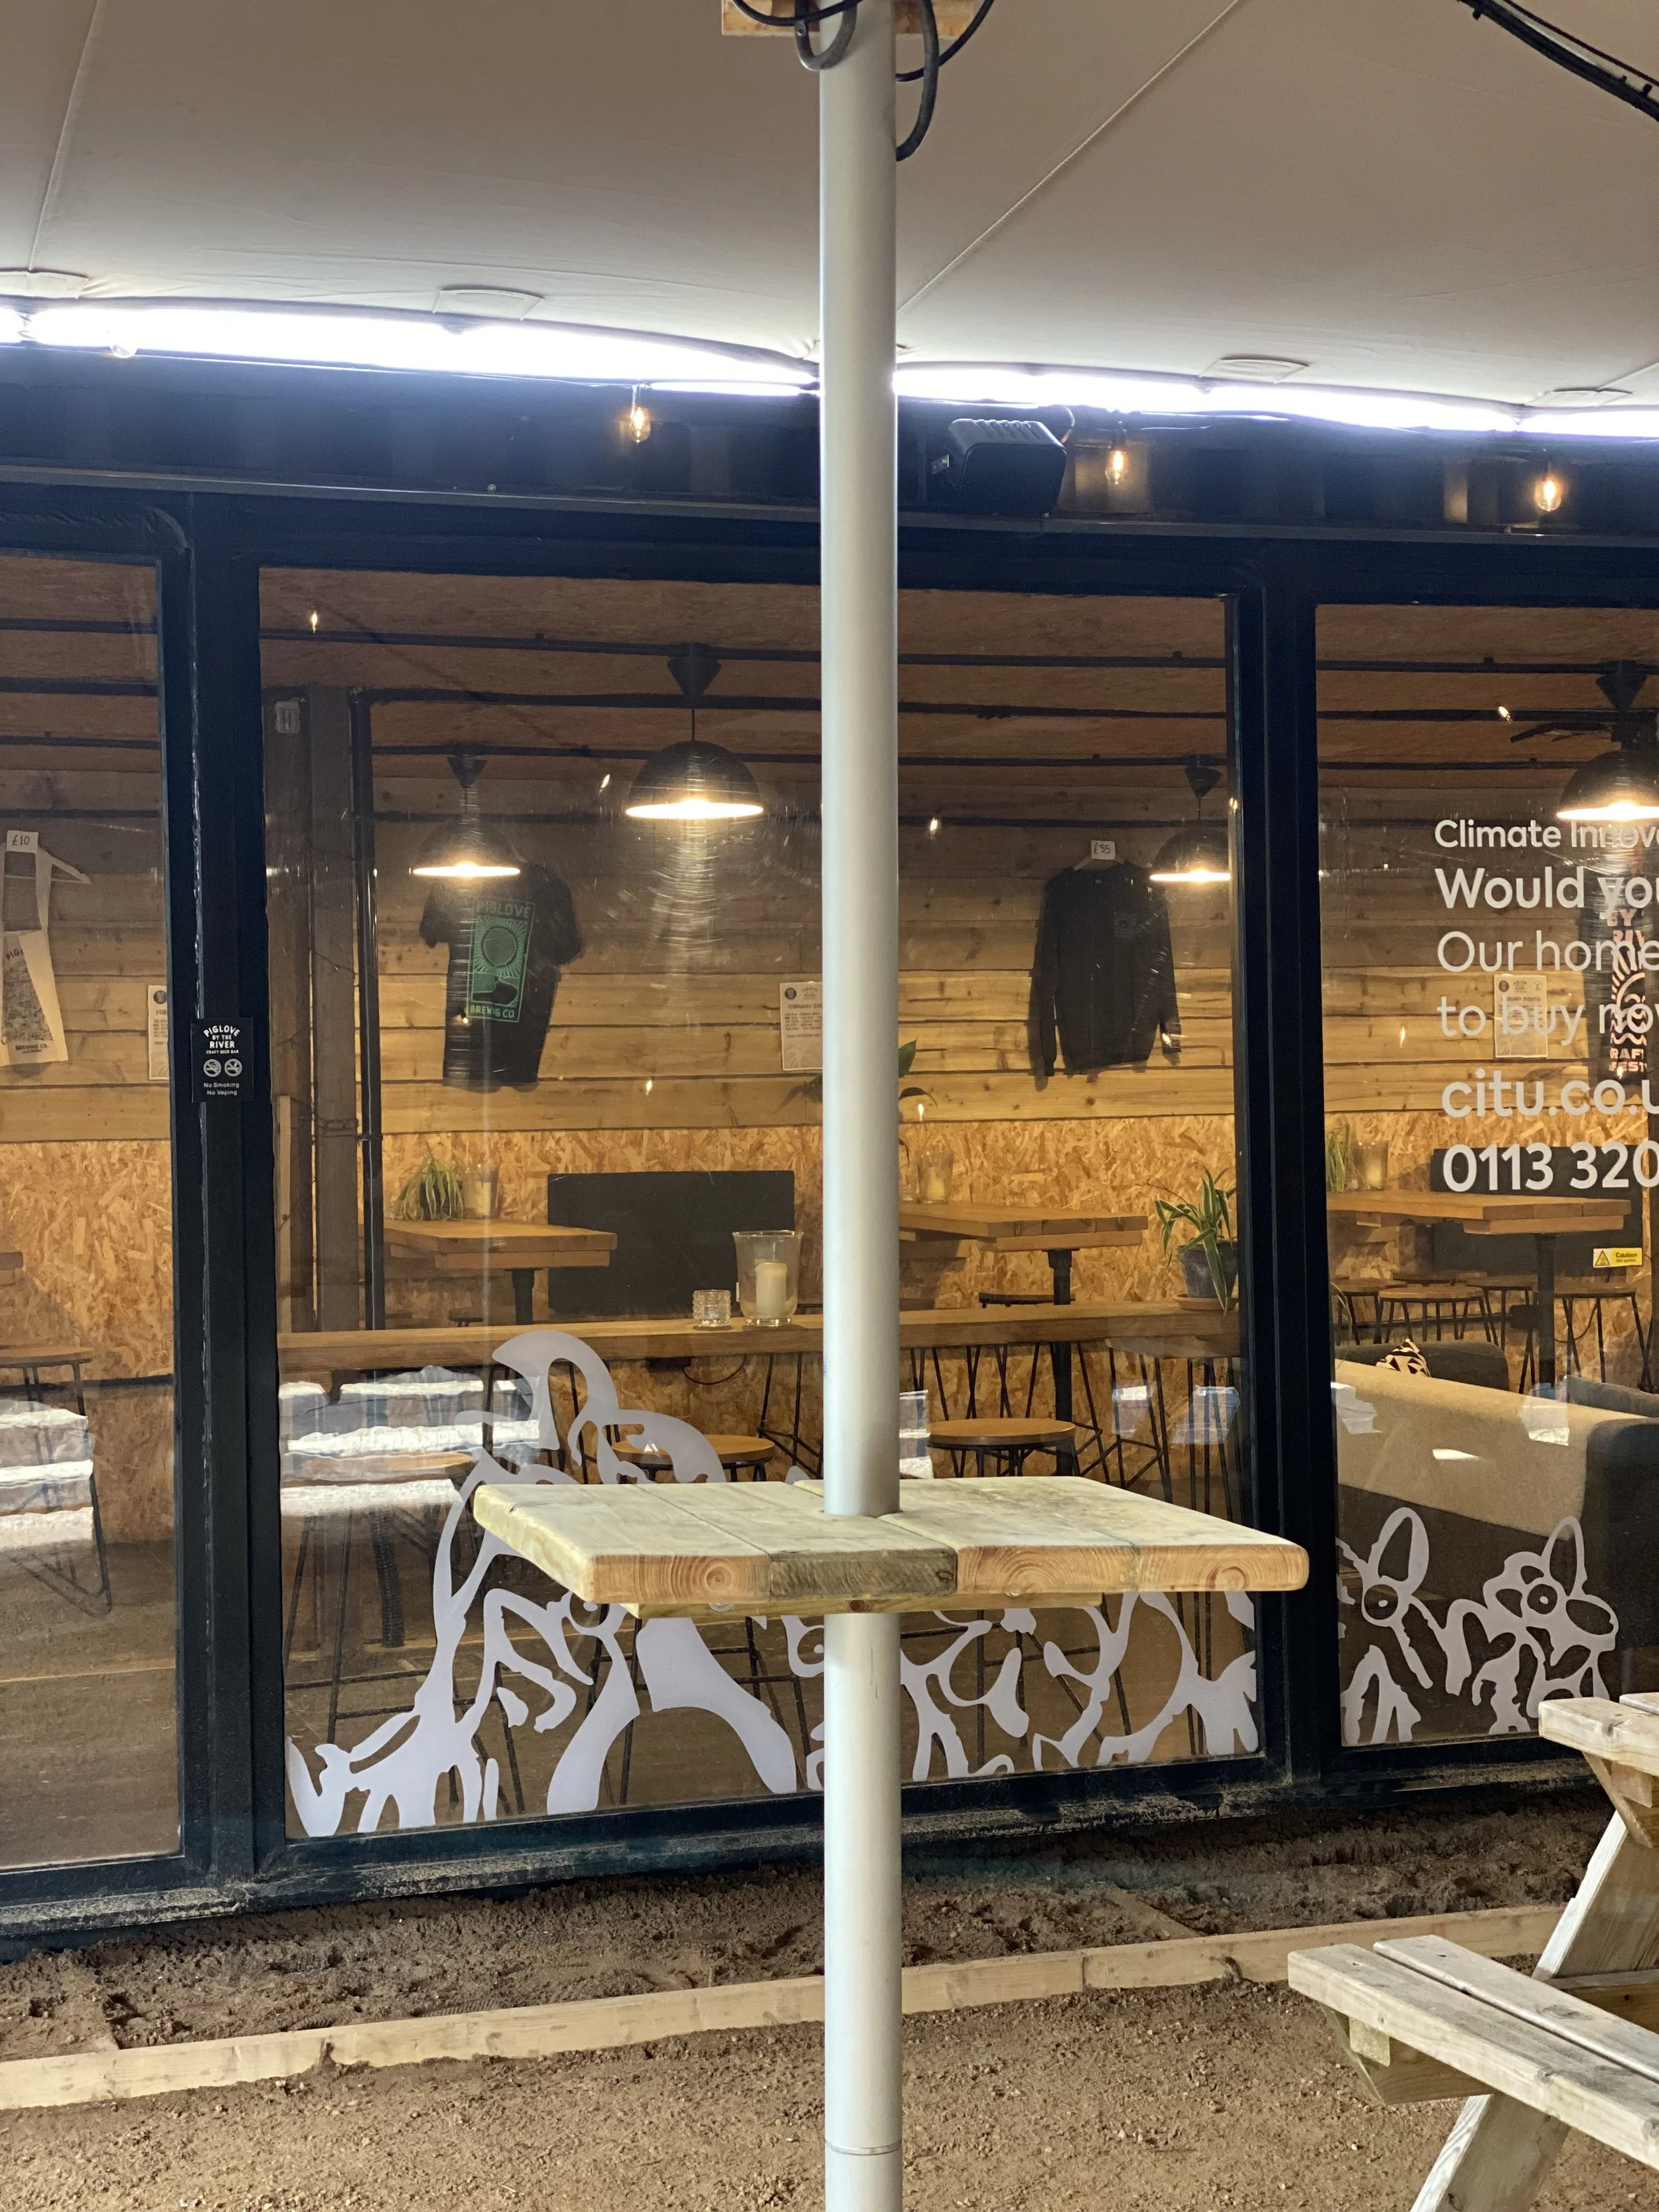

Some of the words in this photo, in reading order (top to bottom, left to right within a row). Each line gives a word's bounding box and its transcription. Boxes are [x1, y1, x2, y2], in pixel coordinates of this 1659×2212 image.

[12, 834, 31, 846] £10
[1435, 819, 1561, 849] Climate
[1571, 820, 1659, 849] Innov
[1435, 866, 1585, 909] Would
[1597, 876, 1659, 920] yo
[1437, 930, 1523, 972] Our
[203, 1025, 240, 1037] PIGLOVE
[1437, 995, 1486, 1037] to
[1501, 994, 1585, 1046] buy
[1599, 1002, 1659, 1034] no
[1443, 1141, 1553, 1192] 0113
[1569, 1139, 1659, 1189] 320
